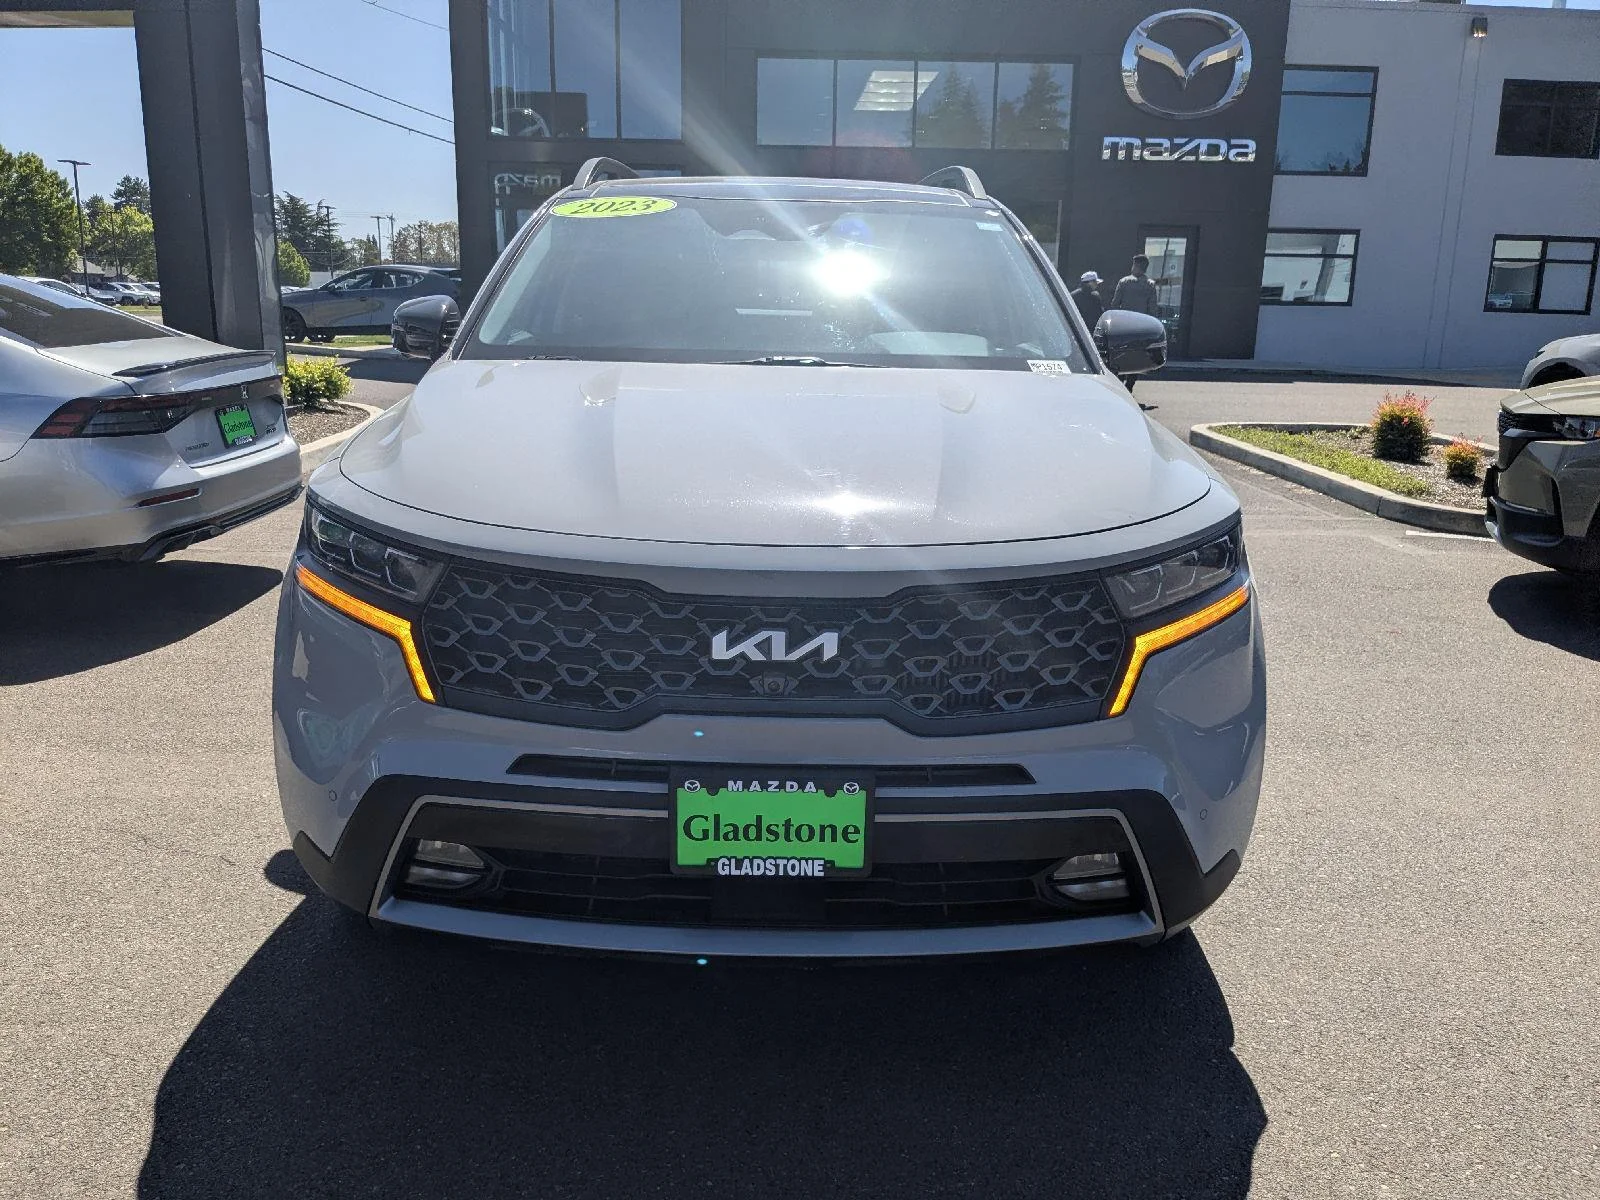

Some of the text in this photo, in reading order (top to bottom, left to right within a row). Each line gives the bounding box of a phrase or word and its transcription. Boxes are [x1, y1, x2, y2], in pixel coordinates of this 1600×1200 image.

[570, 199, 658, 215] 2023
[712, 629, 839, 662] KIA
[727, 780, 817, 793] MAZDA
[682, 813, 861, 844] Gladstone
[717, 857, 825, 877] GLADSTONE
